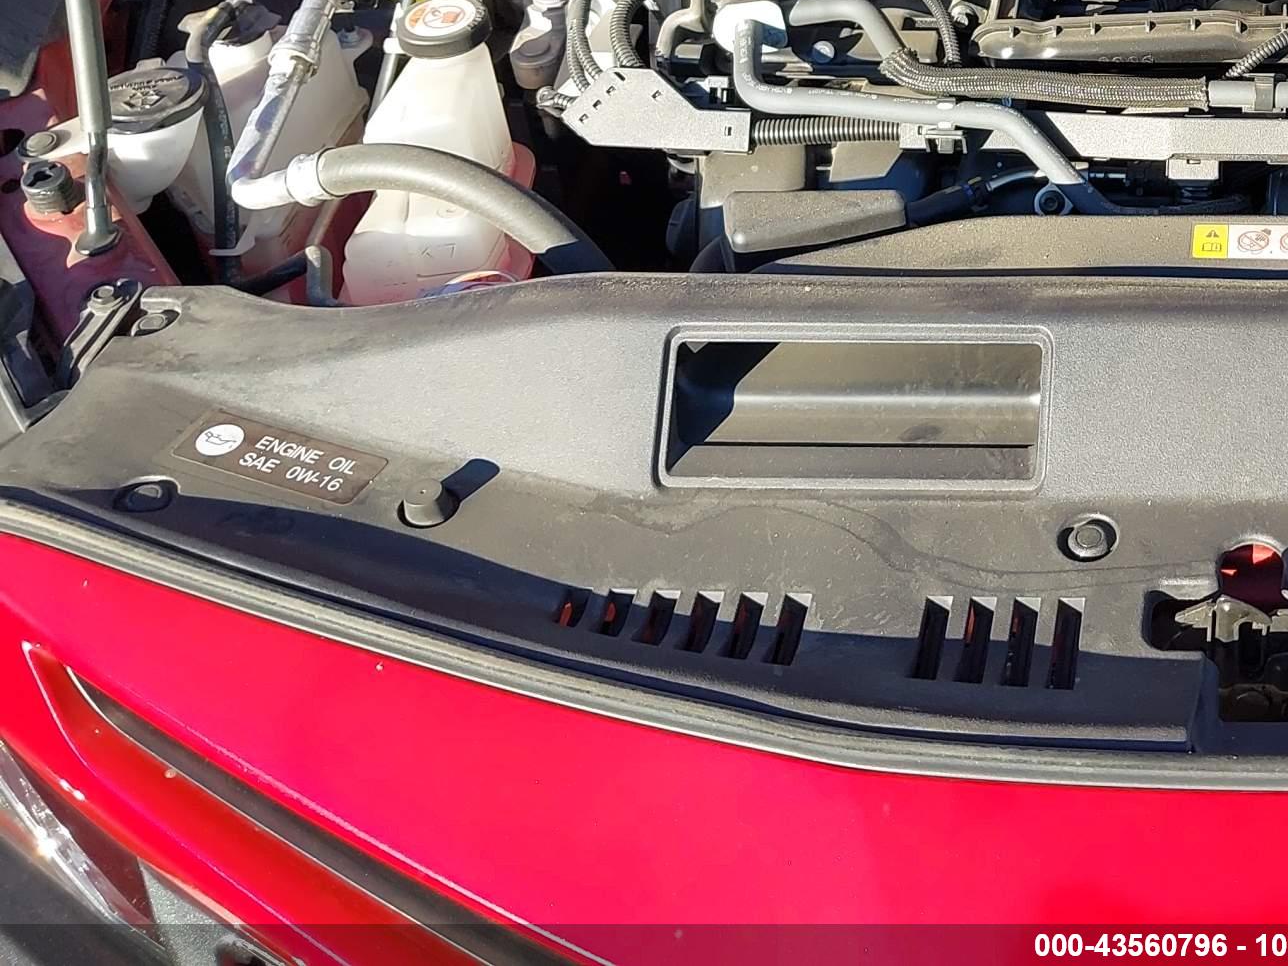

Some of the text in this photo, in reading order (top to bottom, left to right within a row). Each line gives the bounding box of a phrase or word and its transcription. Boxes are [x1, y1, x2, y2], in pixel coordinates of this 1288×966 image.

[239, 452, 344, 491] SAE 0W-16
[255, 435, 357, 475] ENGINE OIL
